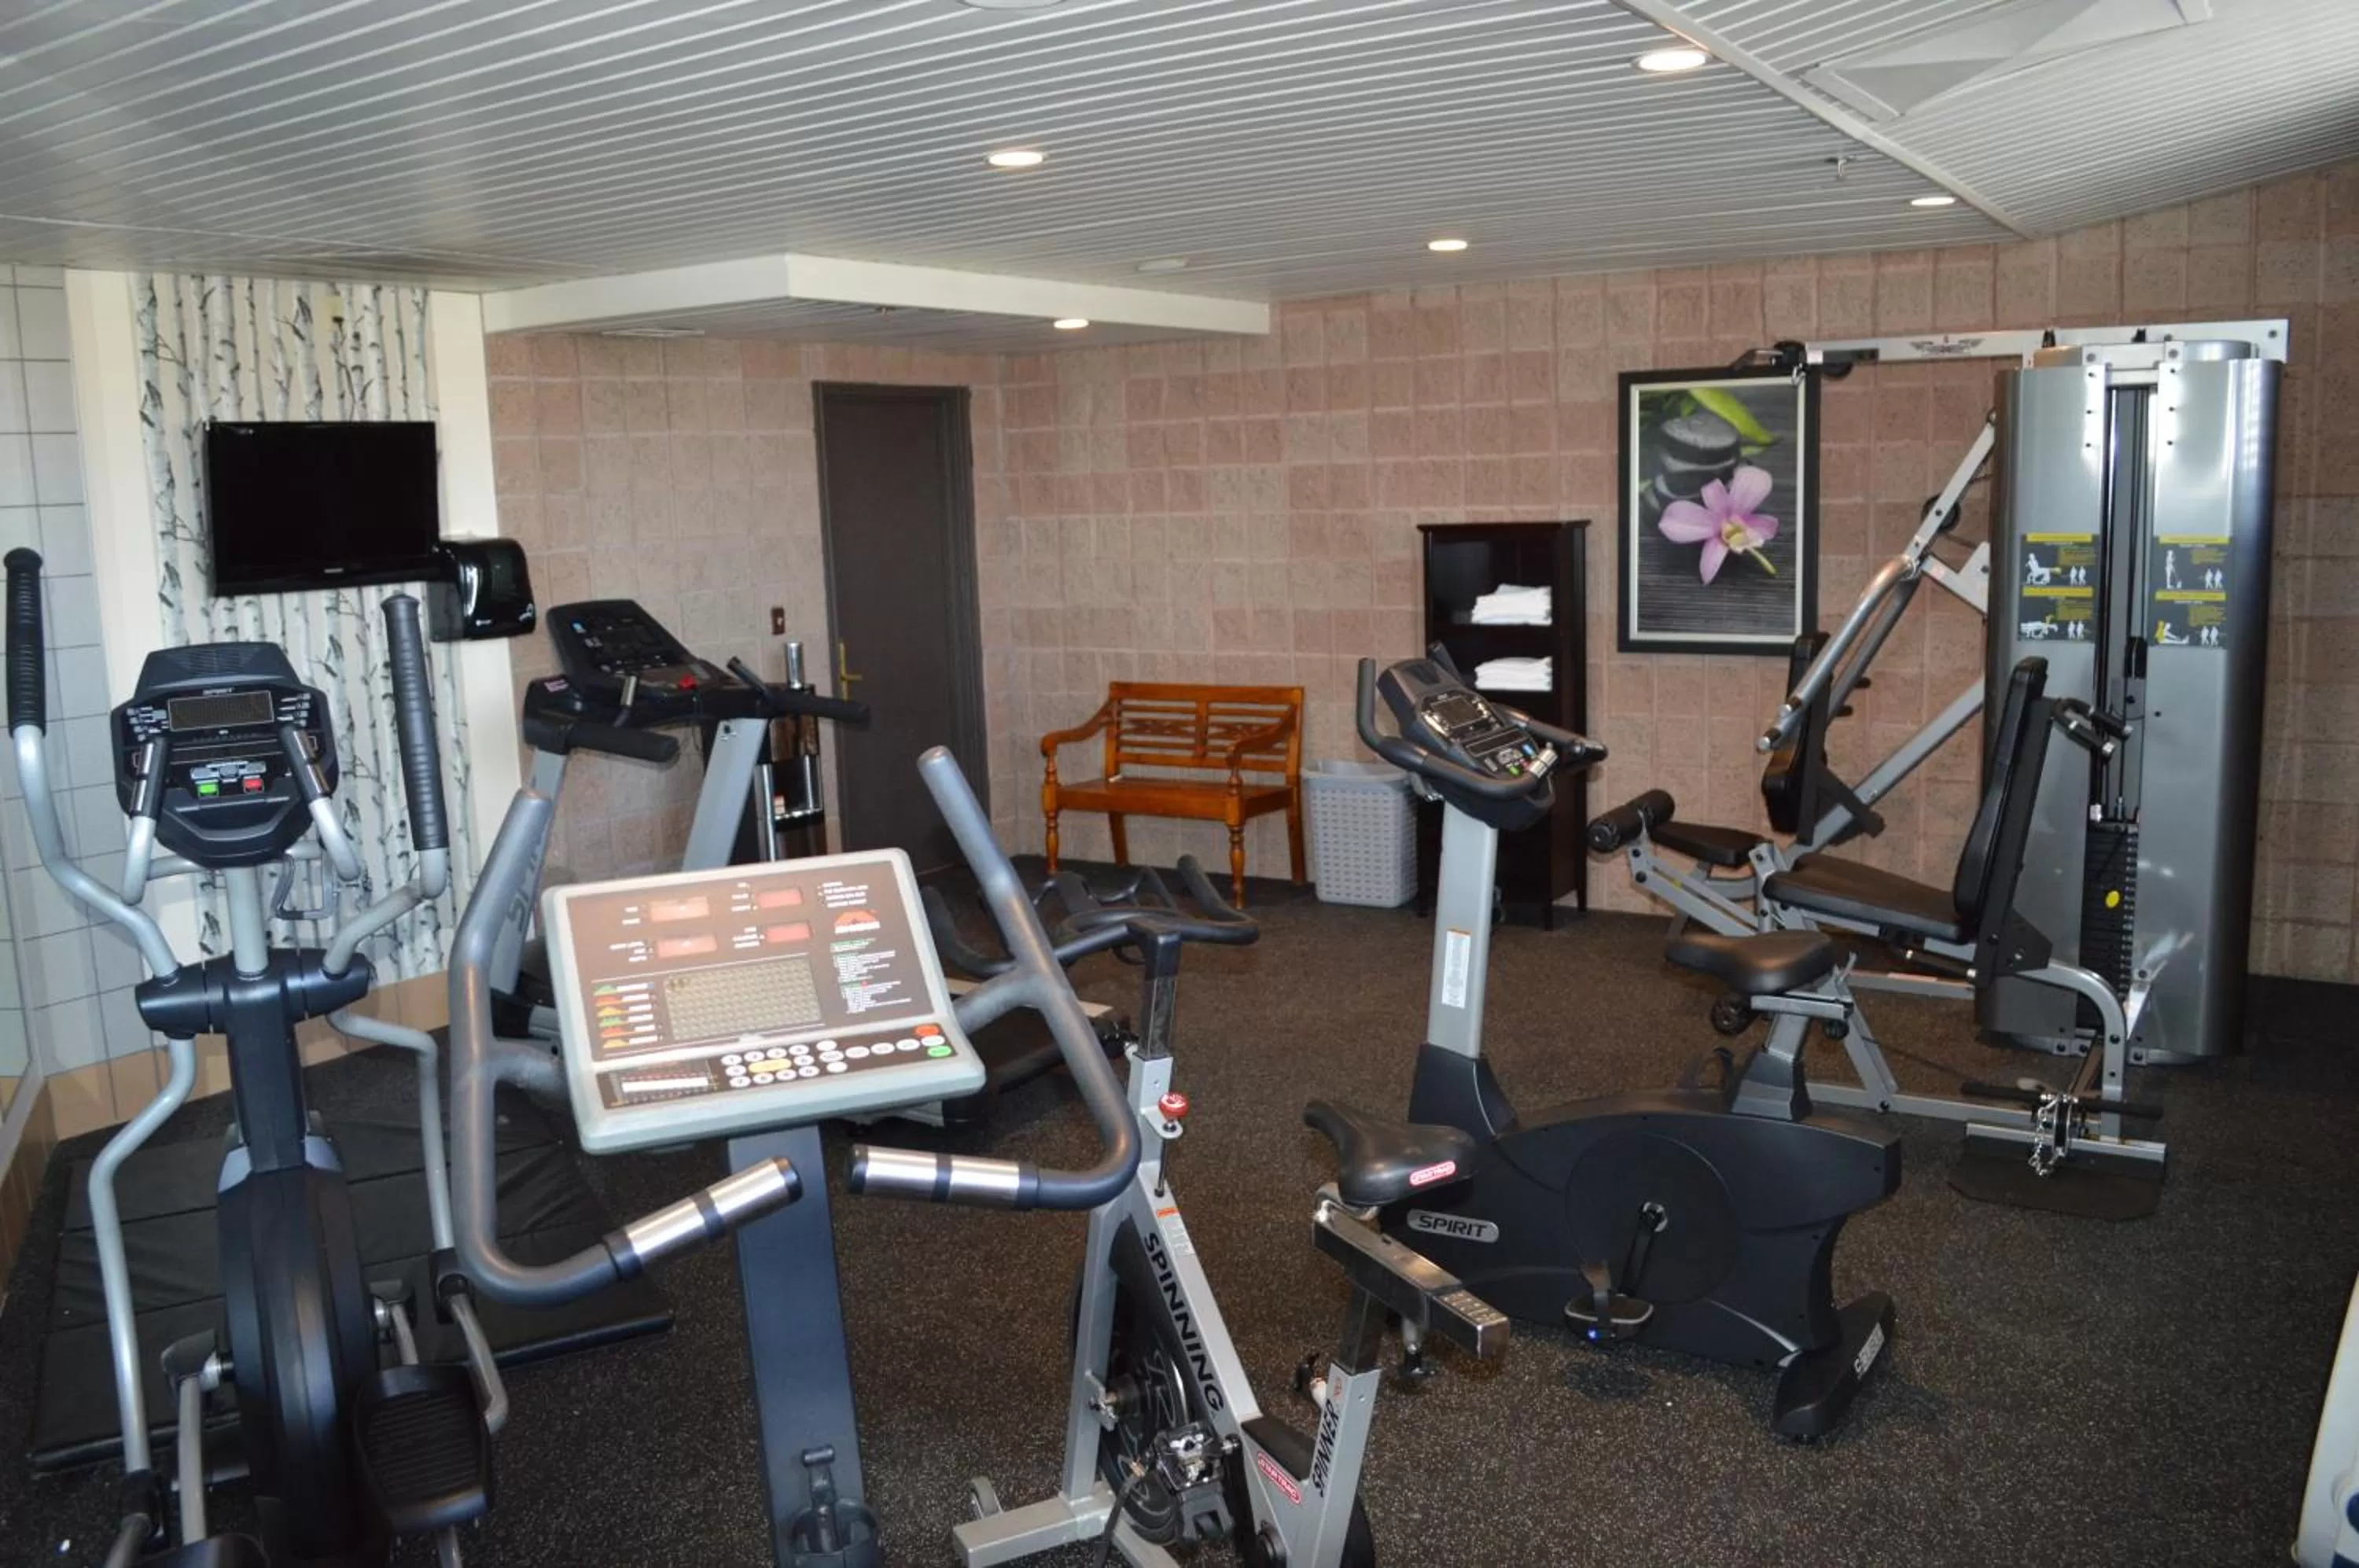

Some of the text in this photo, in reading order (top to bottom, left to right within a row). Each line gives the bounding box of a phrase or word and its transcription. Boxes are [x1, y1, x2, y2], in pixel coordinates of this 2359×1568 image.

[1419, 1215, 1488, 1237] SPIRIT
[1143, 1231, 1224, 1412] SPINNING
[1312, 1398, 1338, 1497] SPINNER
